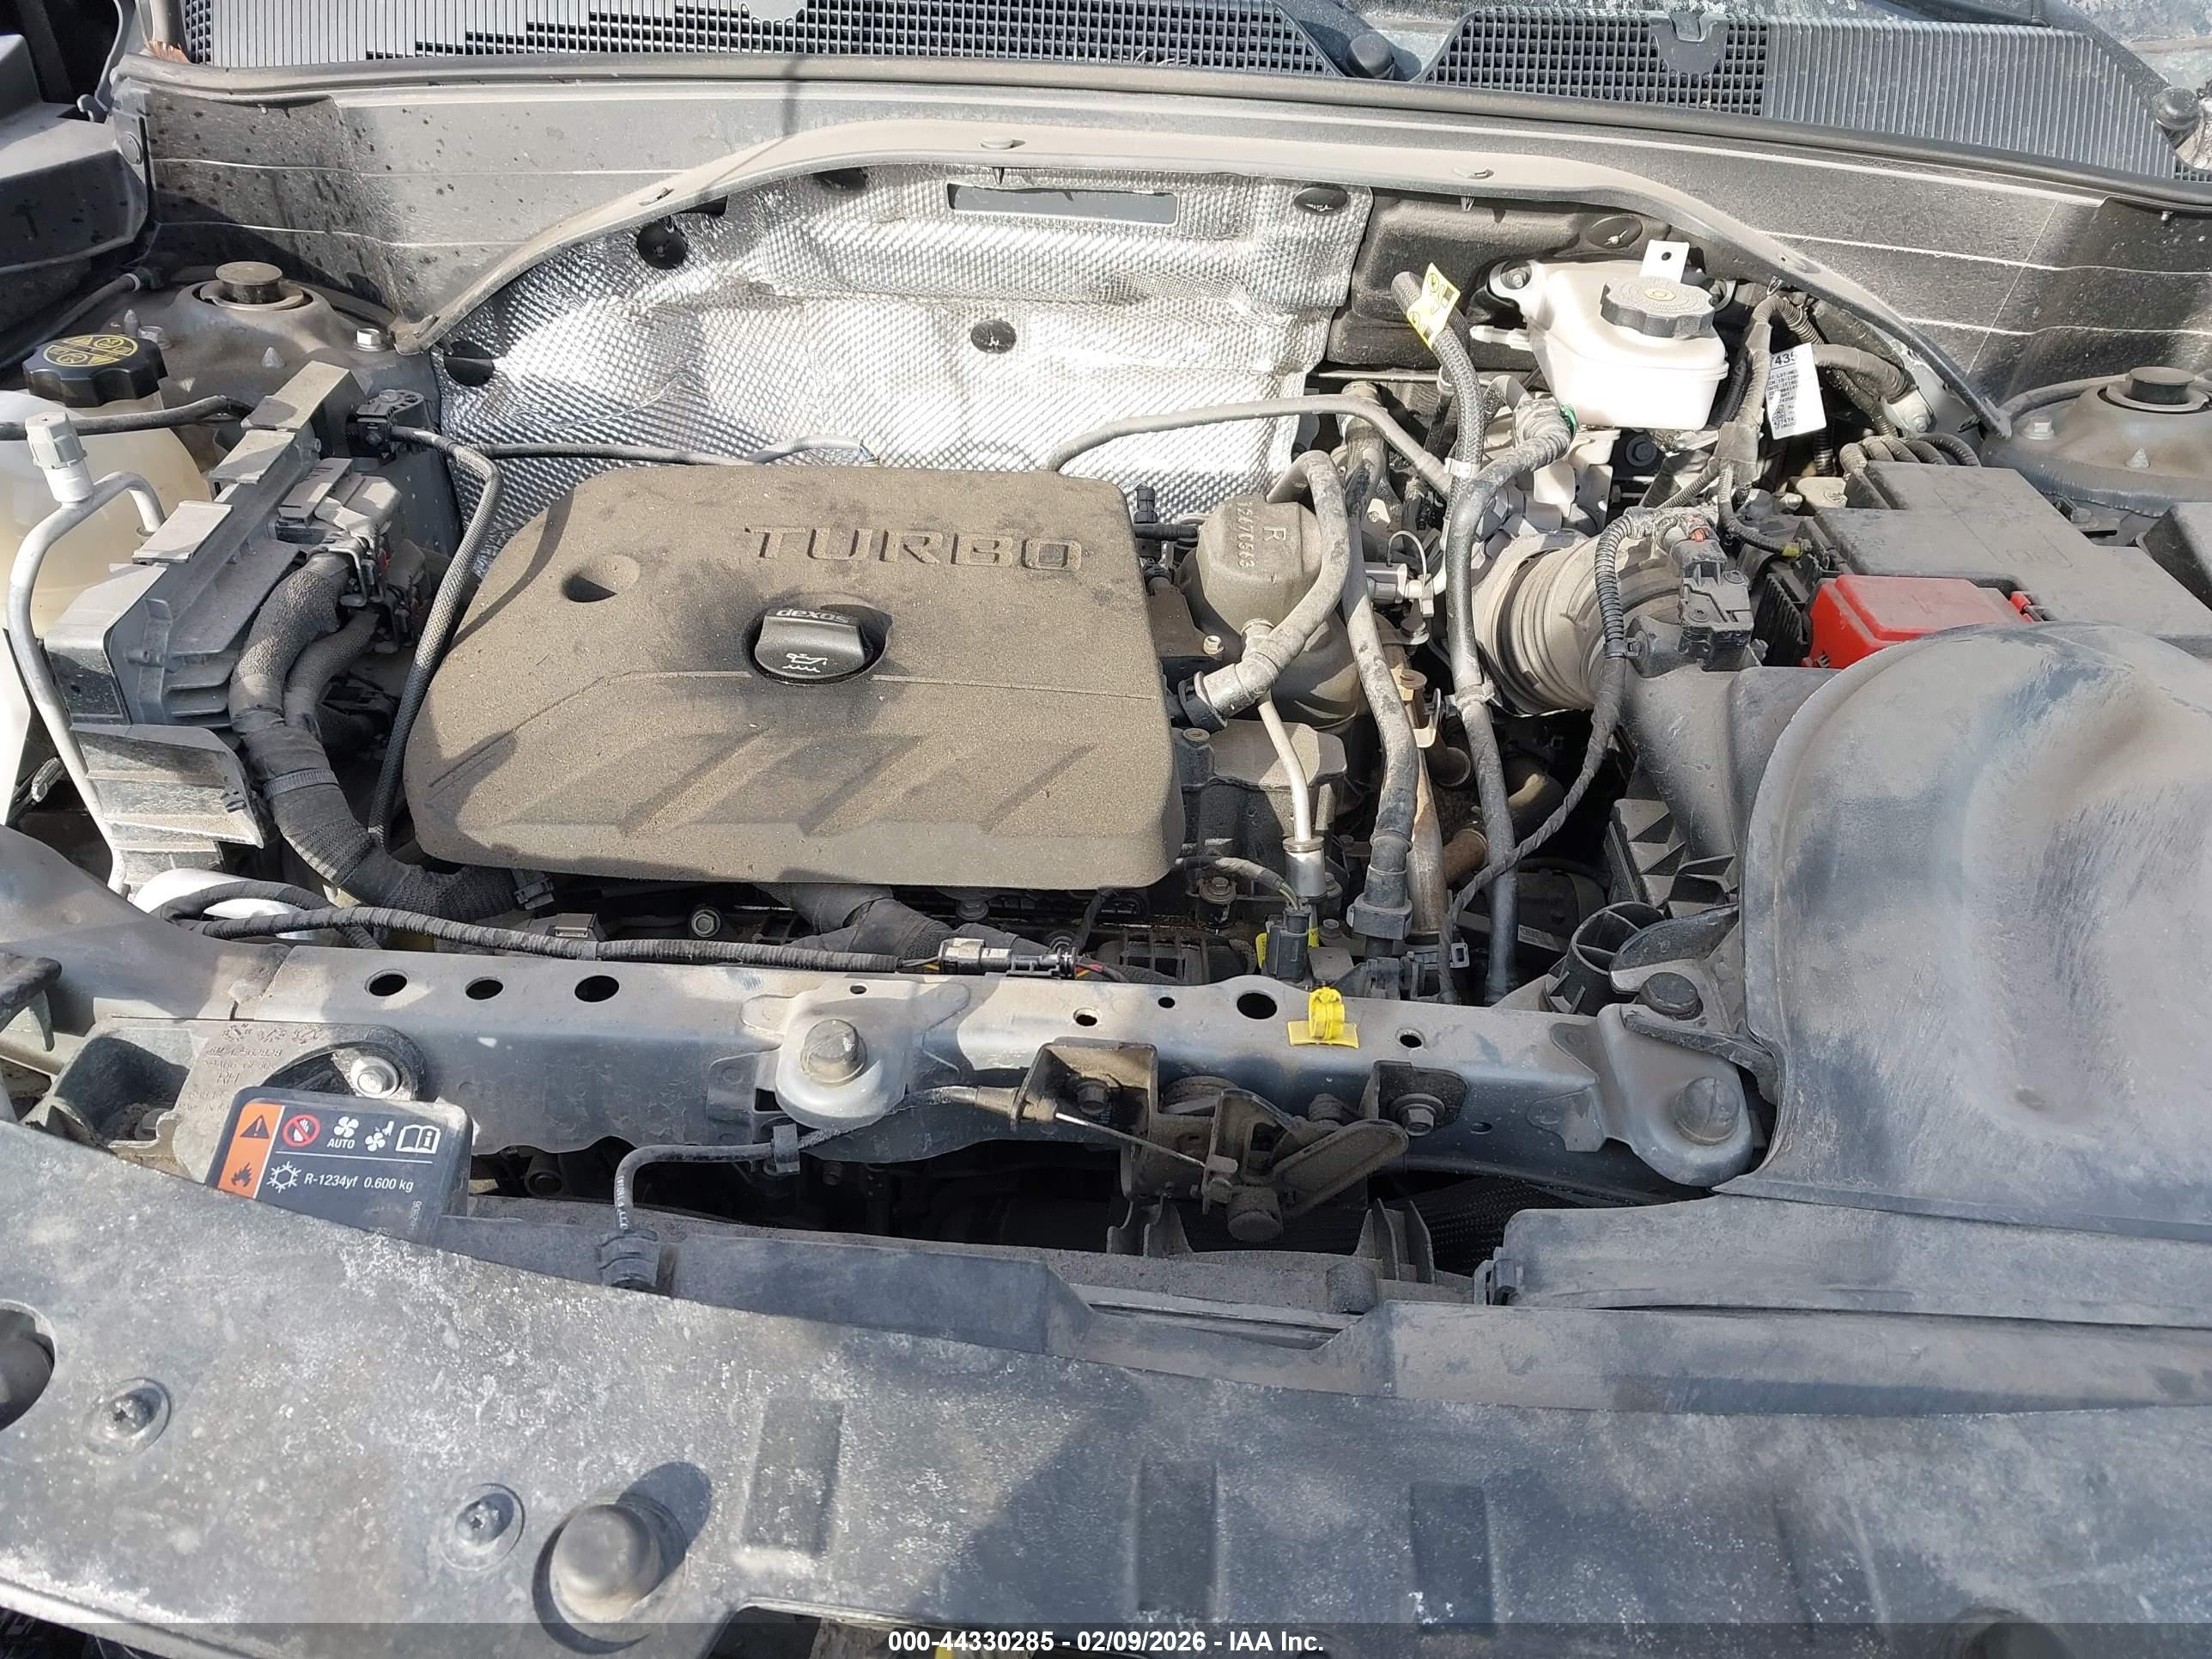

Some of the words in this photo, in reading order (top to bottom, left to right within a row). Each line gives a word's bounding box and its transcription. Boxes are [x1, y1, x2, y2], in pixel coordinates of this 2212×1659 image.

[1262, 526, 1286, 543] R
[744, 526, 1083, 573] TURBO
[775, 607, 855, 624] dexos
[216, 1071, 241, 1085] RH
[326, 1138, 356, 1149] AUTO
[304, 1172, 359, 1189] R-1234yf
[363, 1176, 397, 1190] 0.600
[398, 1179, 414, 1194] kg
